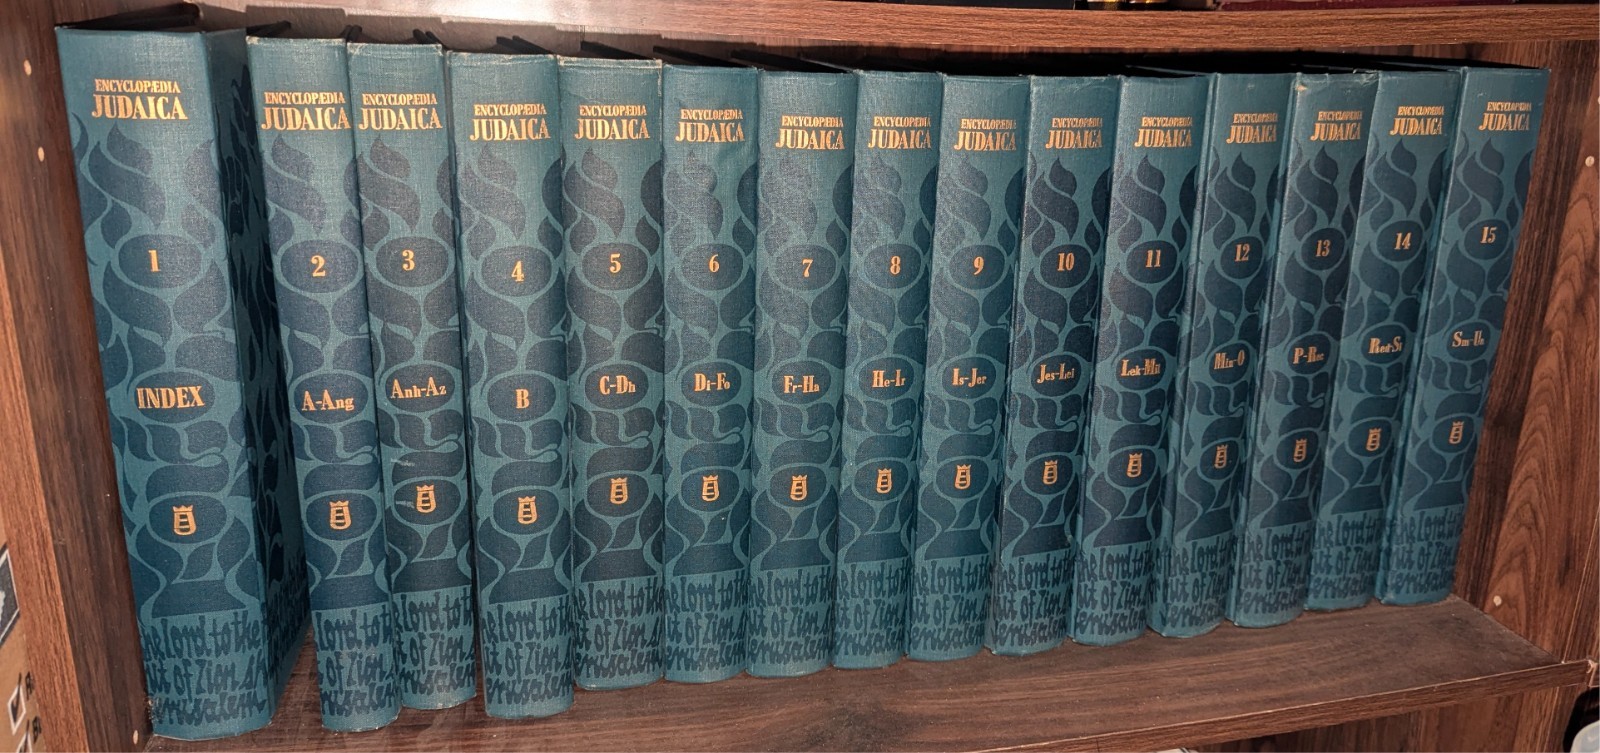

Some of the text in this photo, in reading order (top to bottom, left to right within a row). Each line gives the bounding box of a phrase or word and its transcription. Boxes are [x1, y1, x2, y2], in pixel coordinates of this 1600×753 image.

[91, 95, 189, 122] JUDAICA
[260, 106, 351, 132] JUDAICA
[357, 107, 442, 132] JUDAICA
[573, 118, 650, 142] JUDAICA
[1388, 116, 1443, 136] JUDAICA
[1477, 112, 1529, 131] JUDAICA
[468, 118, 550, 143] JUDAICA
[674, 121, 744, 144] JUDAICA
[773, 128, 845, 151] JUDAICA
[867, 128, 931, 150] JUDAICA
[952, 130, 1015, 152] JUDAICA
[1044, 129, 1101, 150] JUDAICA
[1132, 128, 1191, 149] JUDAICA
[1225, 124, 1276, 144] JUDAICA
[1309, 121, 1361, 142] JUDAICA
[1394, 232, 1411, 250] 14
[1479, 226, 1496, 244] 15
[1145, 249, 1161, 268] 11
[1234, 243, 1250, 262] 12
[1315, 240, 1330, 257] 13
[148, 249, 161, 273] 1
[309, 254, 327, 278] 2
[400, 249, 416, 272] 3
[608, 252, 622, 276] 5
[708, 254, 721, 274] 6
[801, 257, 814, 278] 7
[888, 255, 901, 276] 8
[972, 256, 985, 276] 9
[1057, 252, 1075, 272] 10
[510, 260, 525, 283] 4
[693, 372, 731, 393] Di-Fo
[871, 369, 905, 388] He-Ir
[951, 367, 987, 388] Is-Jer
[1036, 363, 1074, 384] Jes-Lei
[390, 376, 447, 399] Anh-Az
[598, 374, 636, 396] C-Dh
[783, 375, 820, 394] Fr-Ha
[137, 385, 205, 410] INDEX
[302, 390, 355, 412] A-Ang
[515, 388, 531, 409] B
